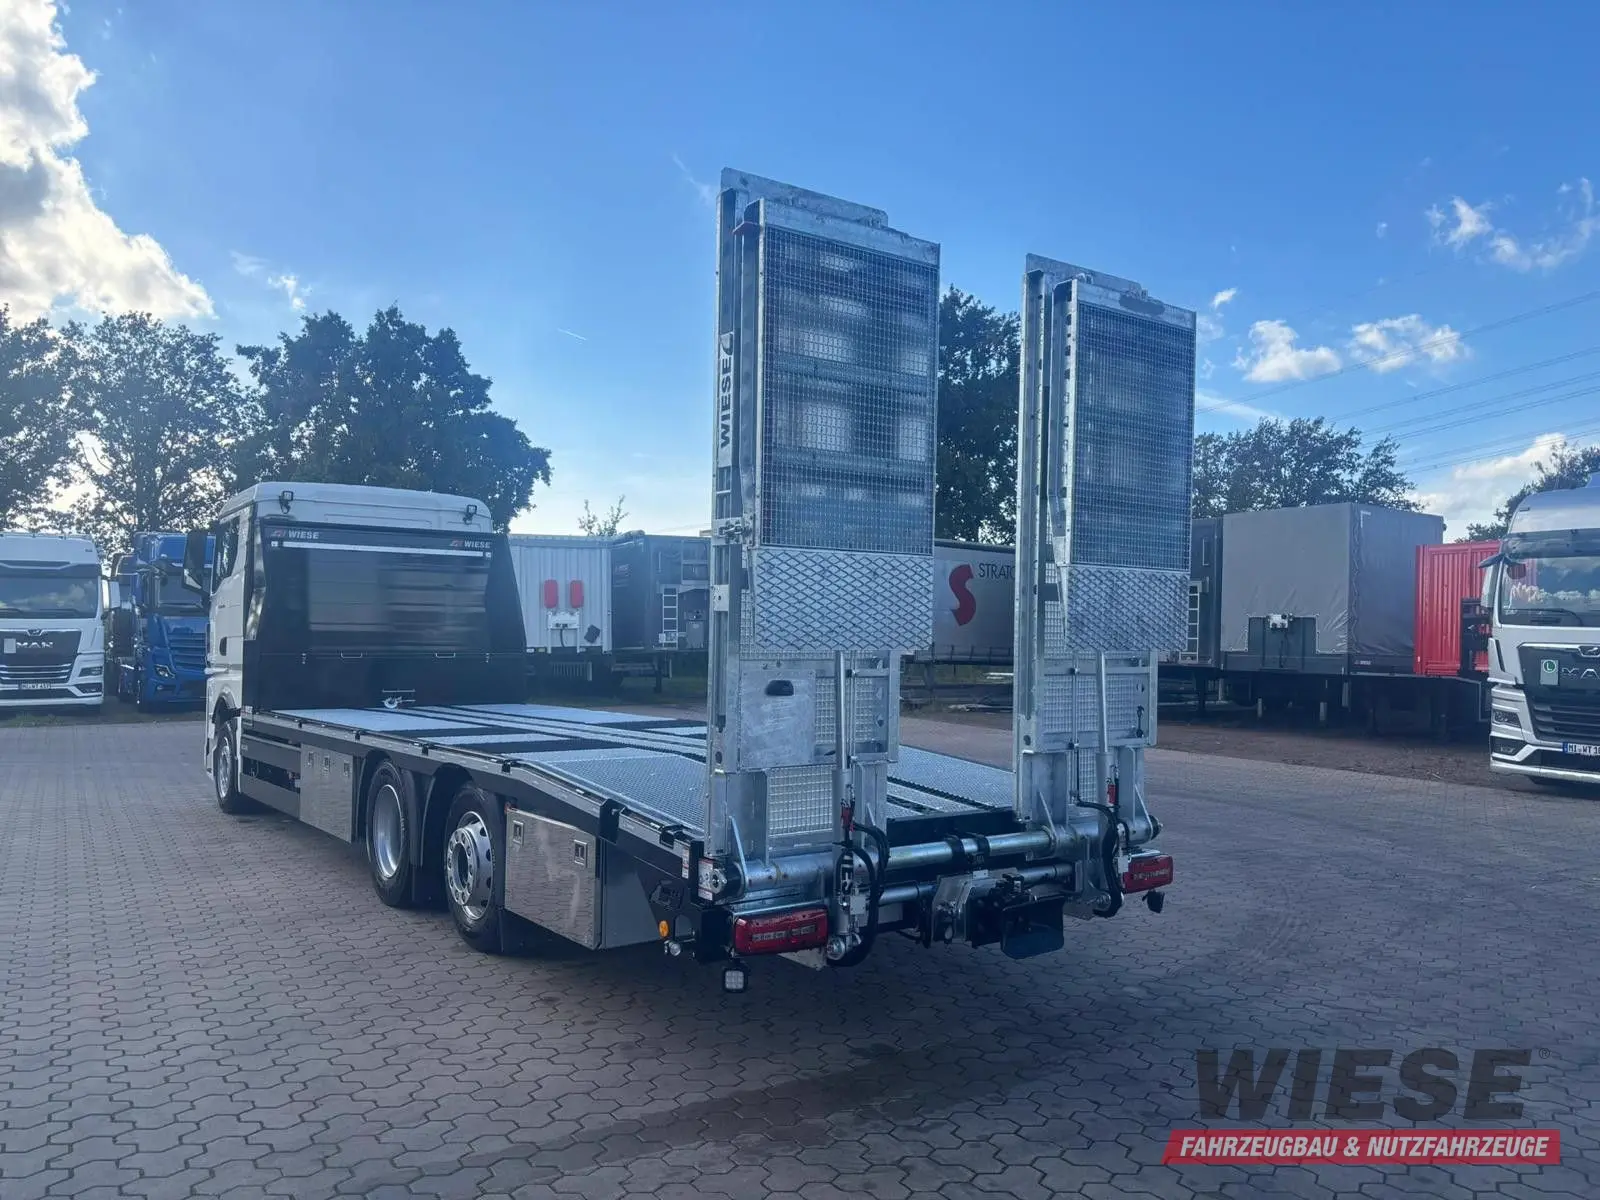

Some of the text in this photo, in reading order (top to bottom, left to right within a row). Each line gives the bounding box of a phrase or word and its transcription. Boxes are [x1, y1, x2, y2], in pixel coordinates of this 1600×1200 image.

[720, 357, 732, 449] WIESE
[288, 530, 320, 540] WIESE
[464, 540, 491, 549] WIESE
[16, 641, 53, 649] MAN
